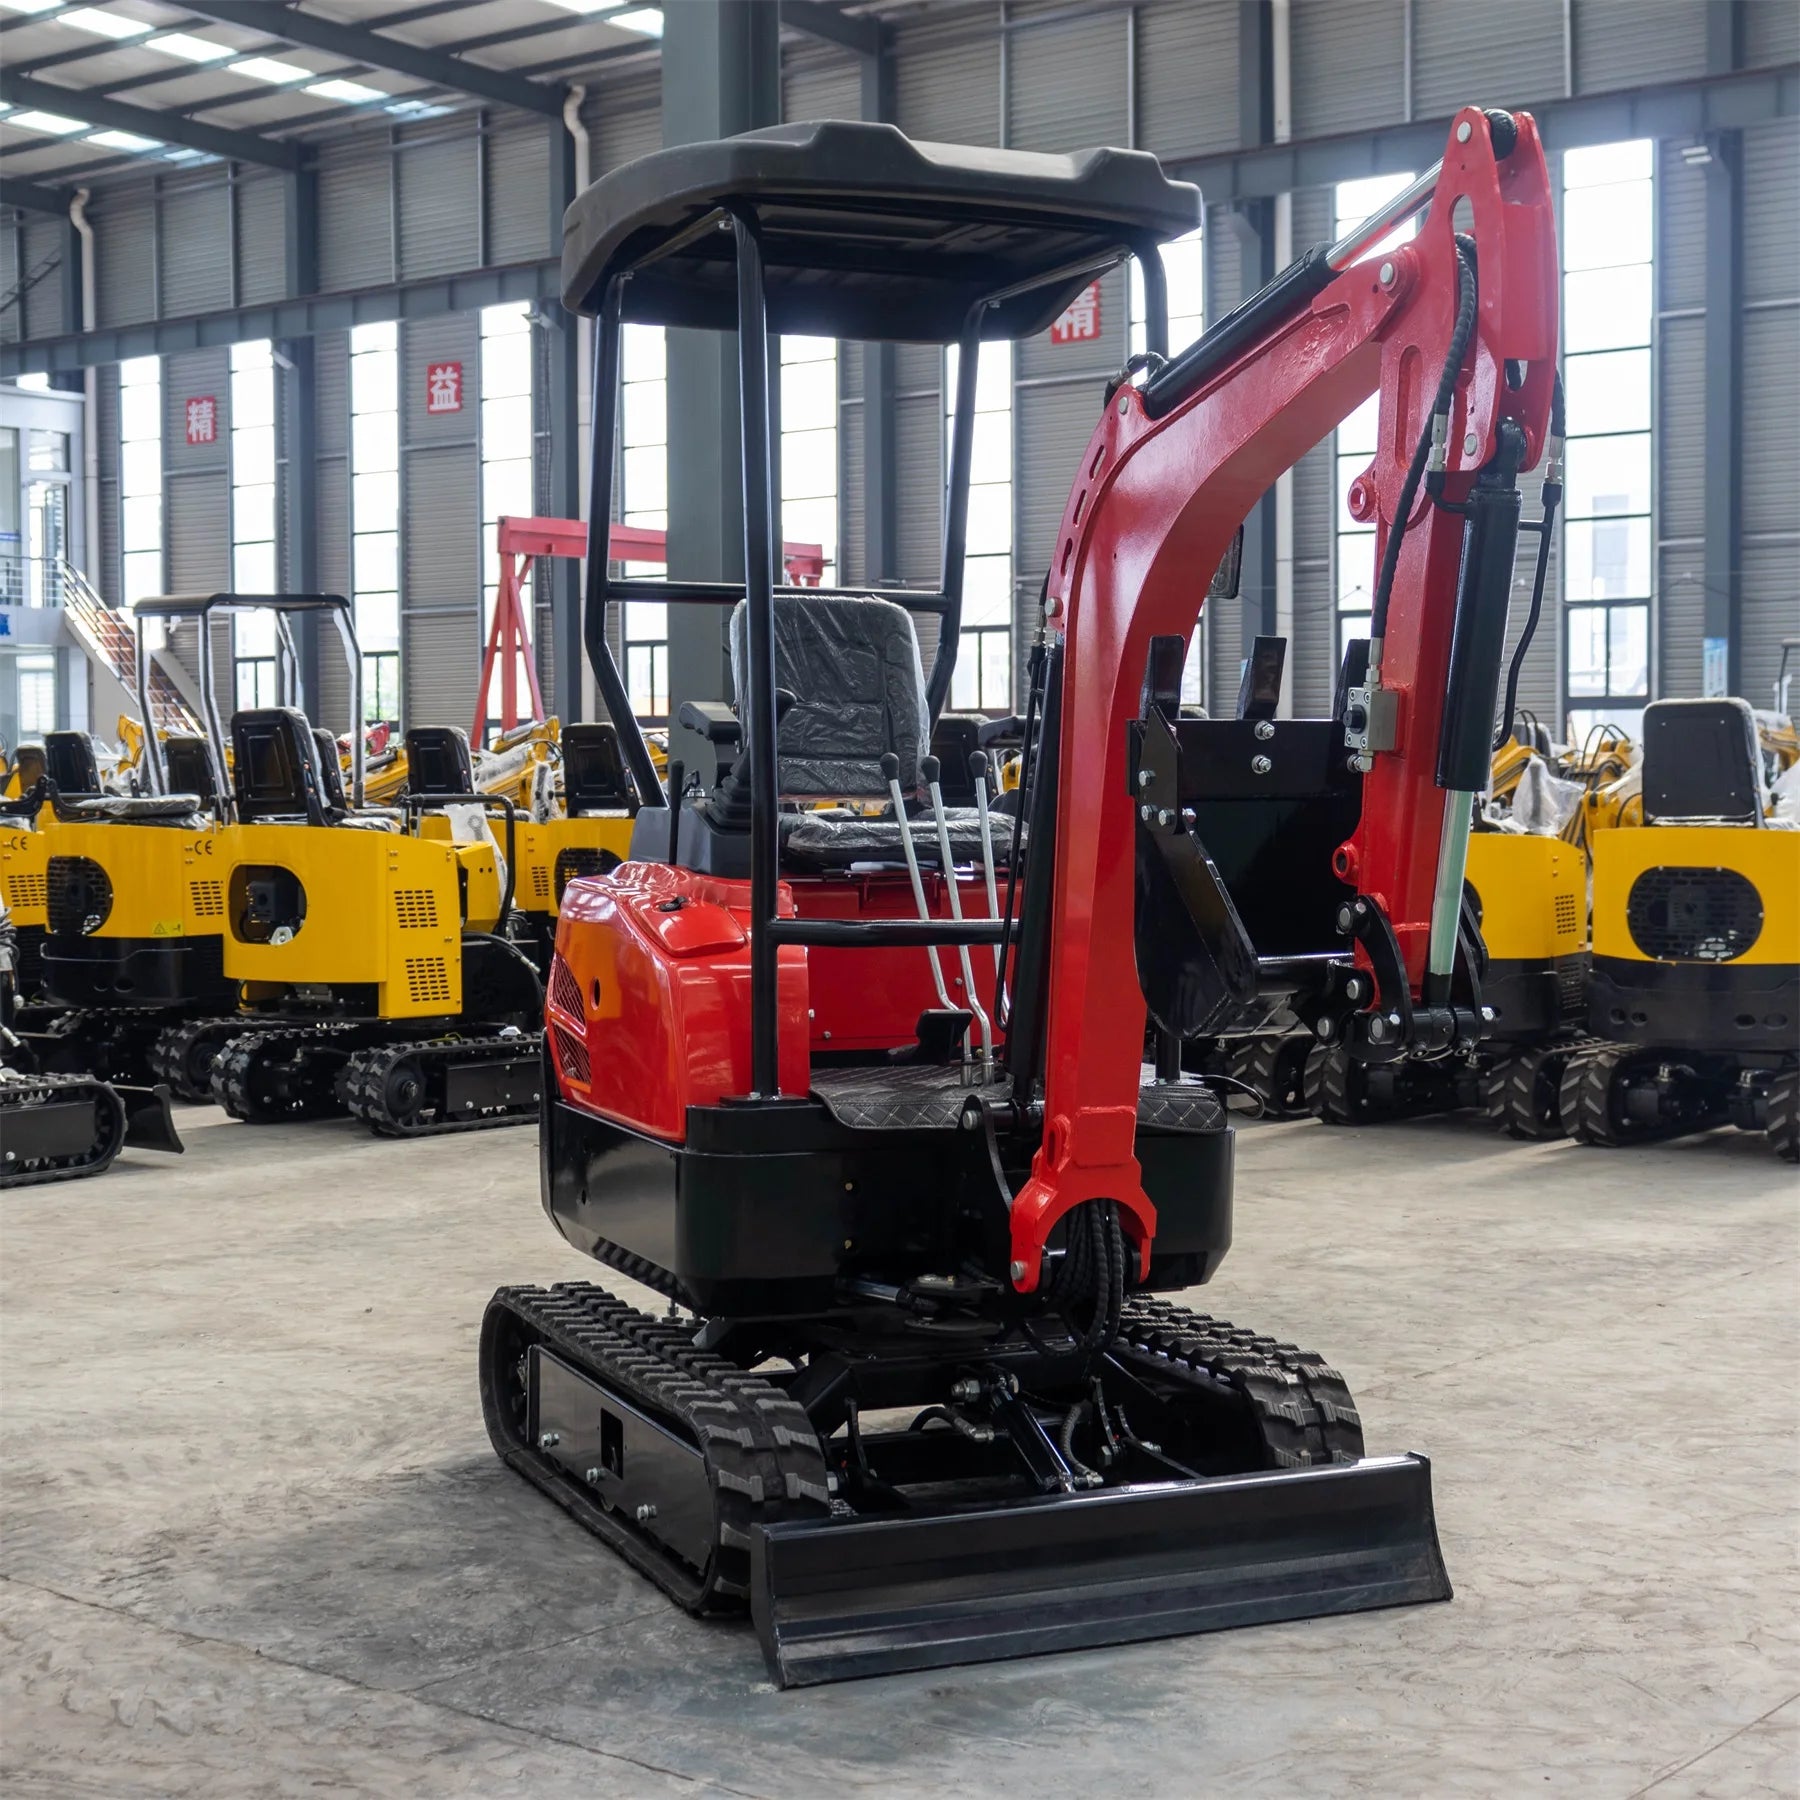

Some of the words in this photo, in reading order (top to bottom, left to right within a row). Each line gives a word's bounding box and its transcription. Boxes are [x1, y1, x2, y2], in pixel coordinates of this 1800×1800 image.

[188, 400, 213, 441] 精
[430, 366, 459, 410] 益
[11, 836, 27, 850] CE
[195, 840, 212, 855] CE
